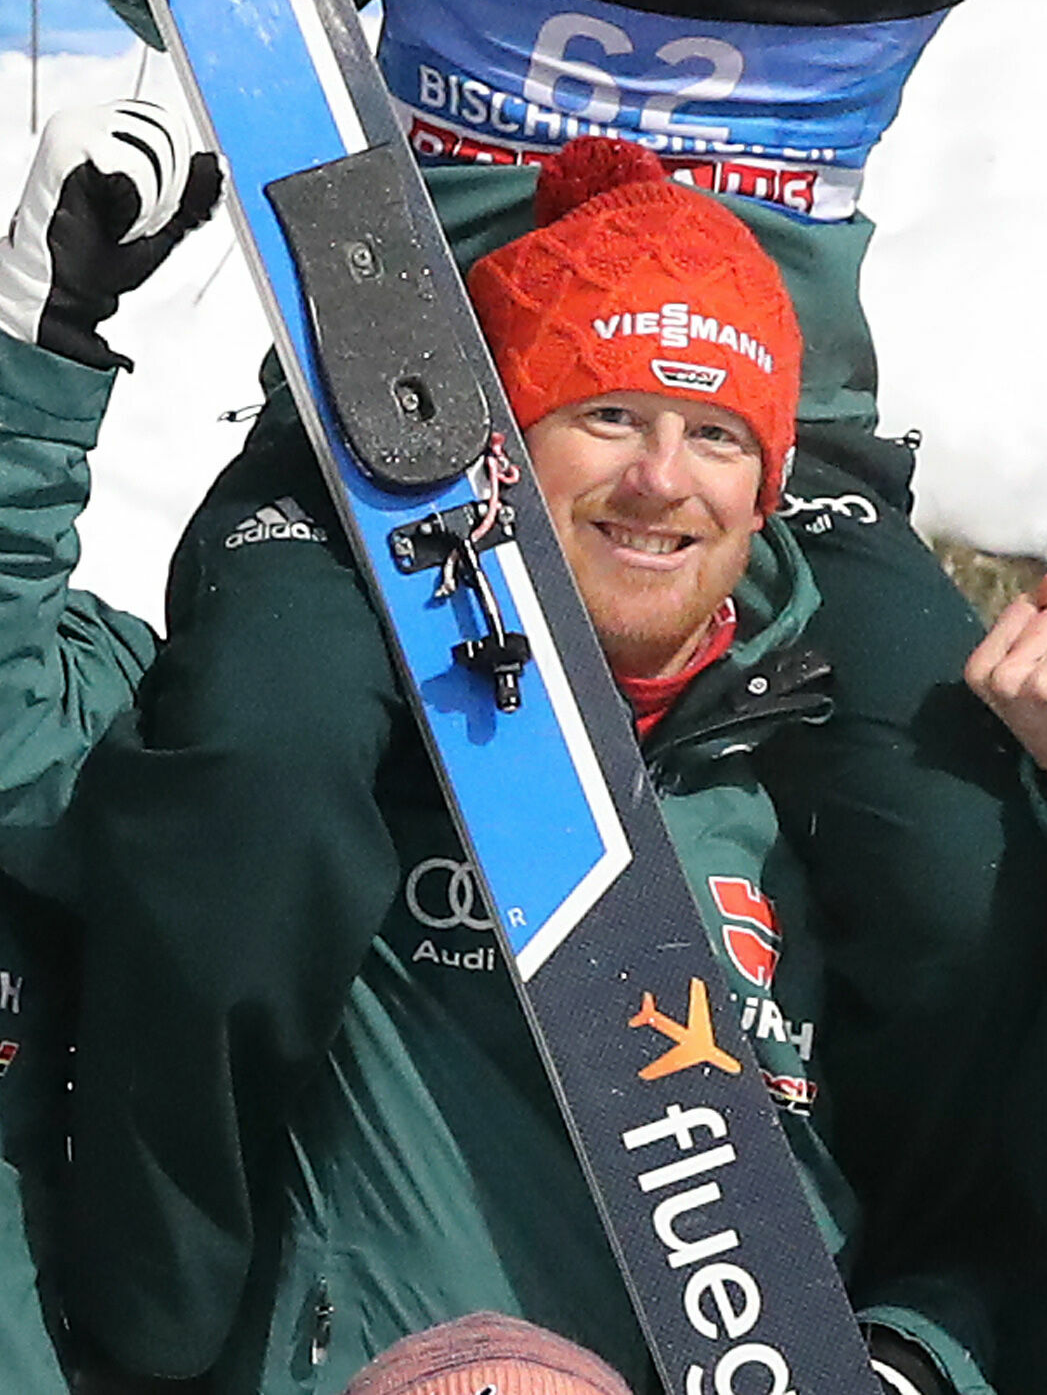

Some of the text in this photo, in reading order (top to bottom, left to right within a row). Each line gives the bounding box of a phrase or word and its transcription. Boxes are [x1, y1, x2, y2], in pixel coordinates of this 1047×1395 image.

[522, 12, 745, 141] 62
[593, 303, 773, 374] VIESSMANN
[412, 939, 495, 971] Audi
